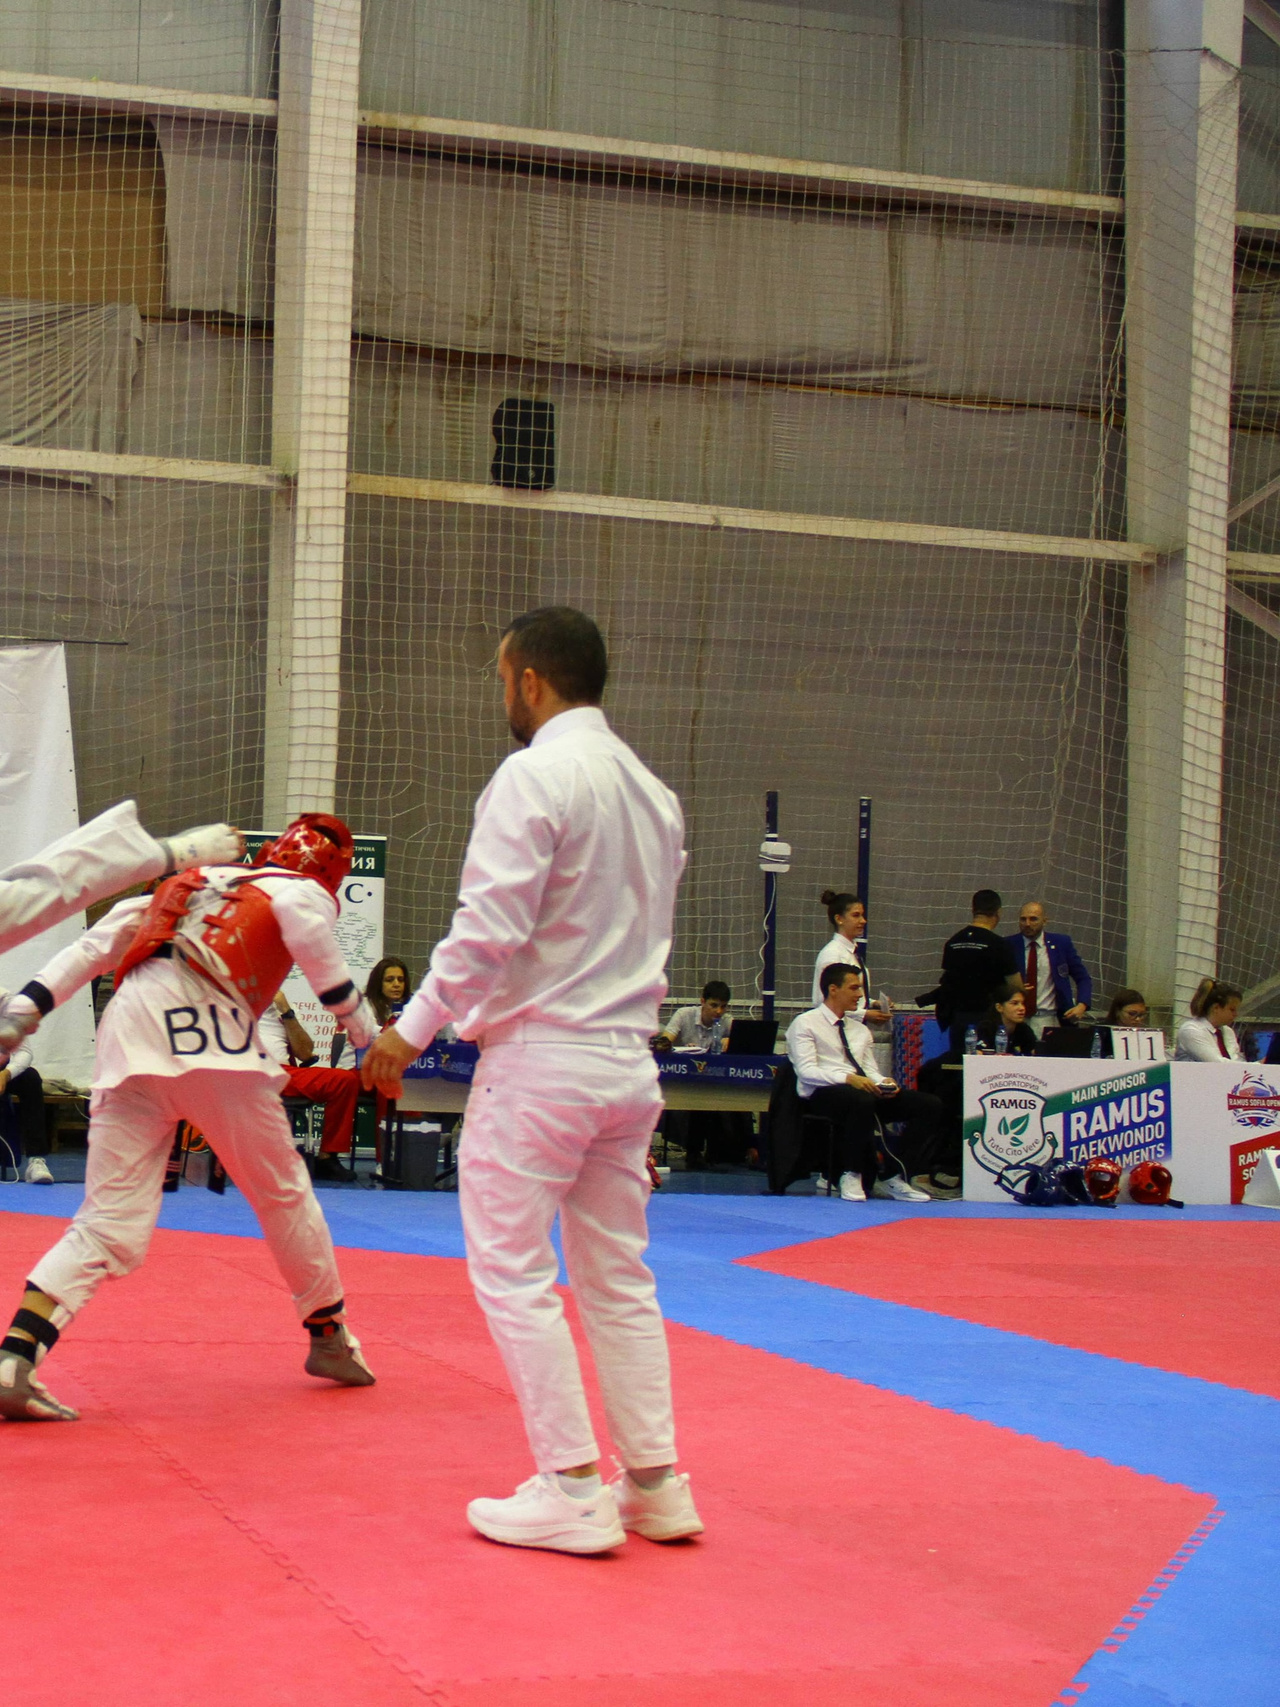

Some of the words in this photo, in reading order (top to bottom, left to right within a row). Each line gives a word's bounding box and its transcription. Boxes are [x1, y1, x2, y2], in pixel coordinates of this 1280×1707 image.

[405, 1057, 435, 1069] MUS
[659, 1063, 688, 1074] AMUS
[729, 1067, 764, 1079] RAMUS
[989, 1080, 1039, 1091] ЛАБОРАТОРИЯ
[1071, 1085, 1098, 1104] MAIN
[1100, 1072, 1146, 1096] SPONSOR
[990, 1098, 1037, 1110] RAMUS
[1228, 1098, 1248, 1107] RAMUS
[1249, 1099, 1265, 1107] SOFIA
[1070, 1088, 1165, 1142] RAMUS
[988, 1137, 1004, 1154] Tuto
[1006, 1147, 1022, 1156] Cito
[1023, 1138, 1040, 1153] Vere
[1069, 1121, 1165, 1163] TAEKWONDO
